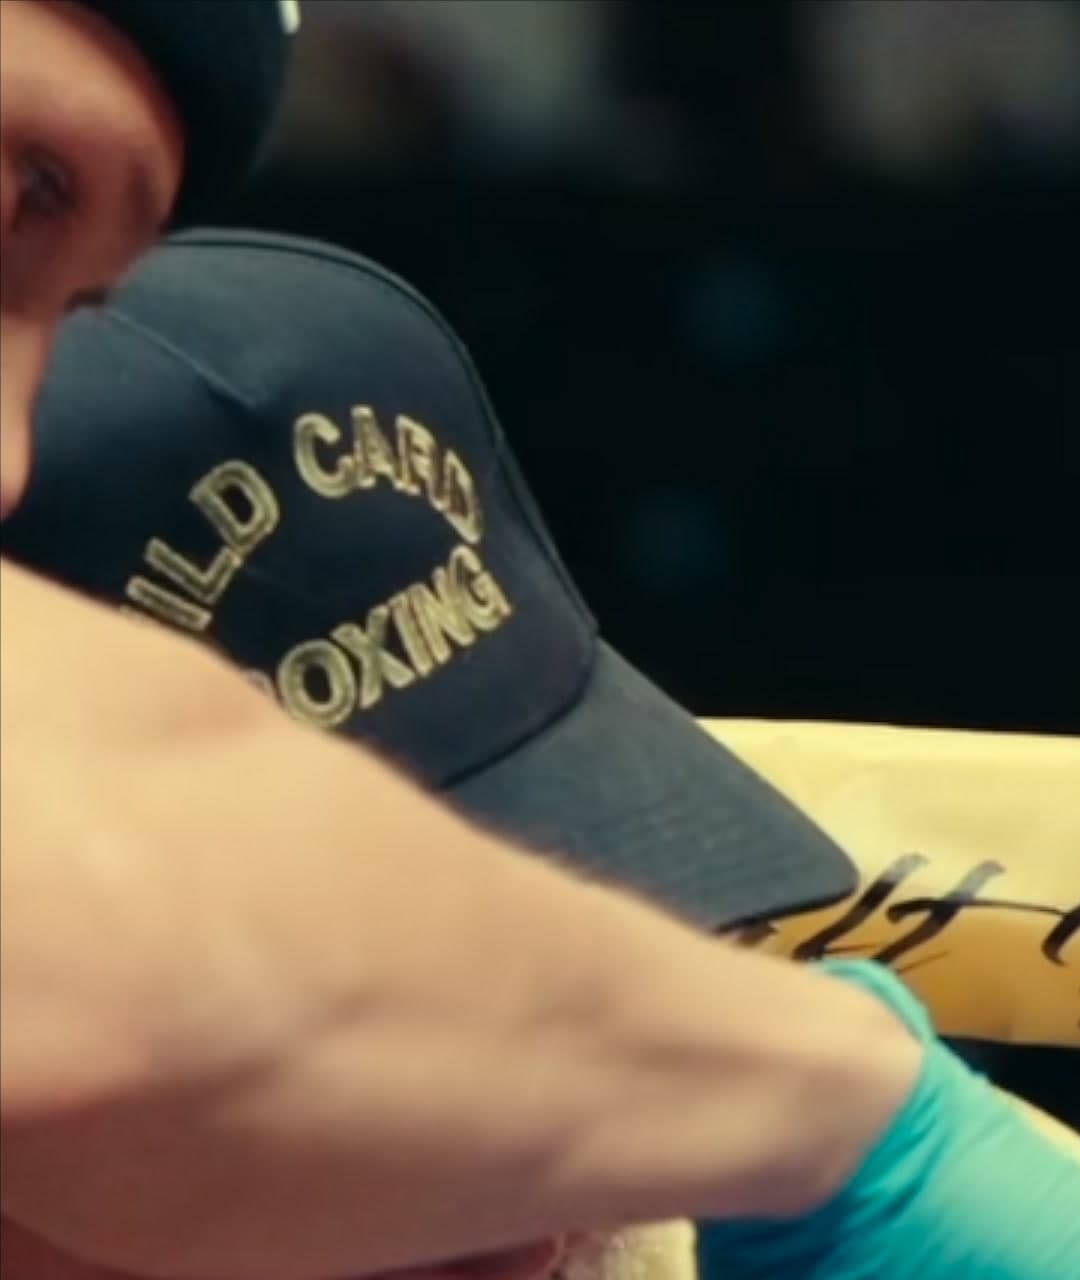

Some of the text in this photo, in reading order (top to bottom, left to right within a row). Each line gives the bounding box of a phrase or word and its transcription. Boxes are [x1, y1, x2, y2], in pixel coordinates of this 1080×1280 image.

[120, 405, 484, 632] ILD CARD
[244, 544, 514, 728] OXING
